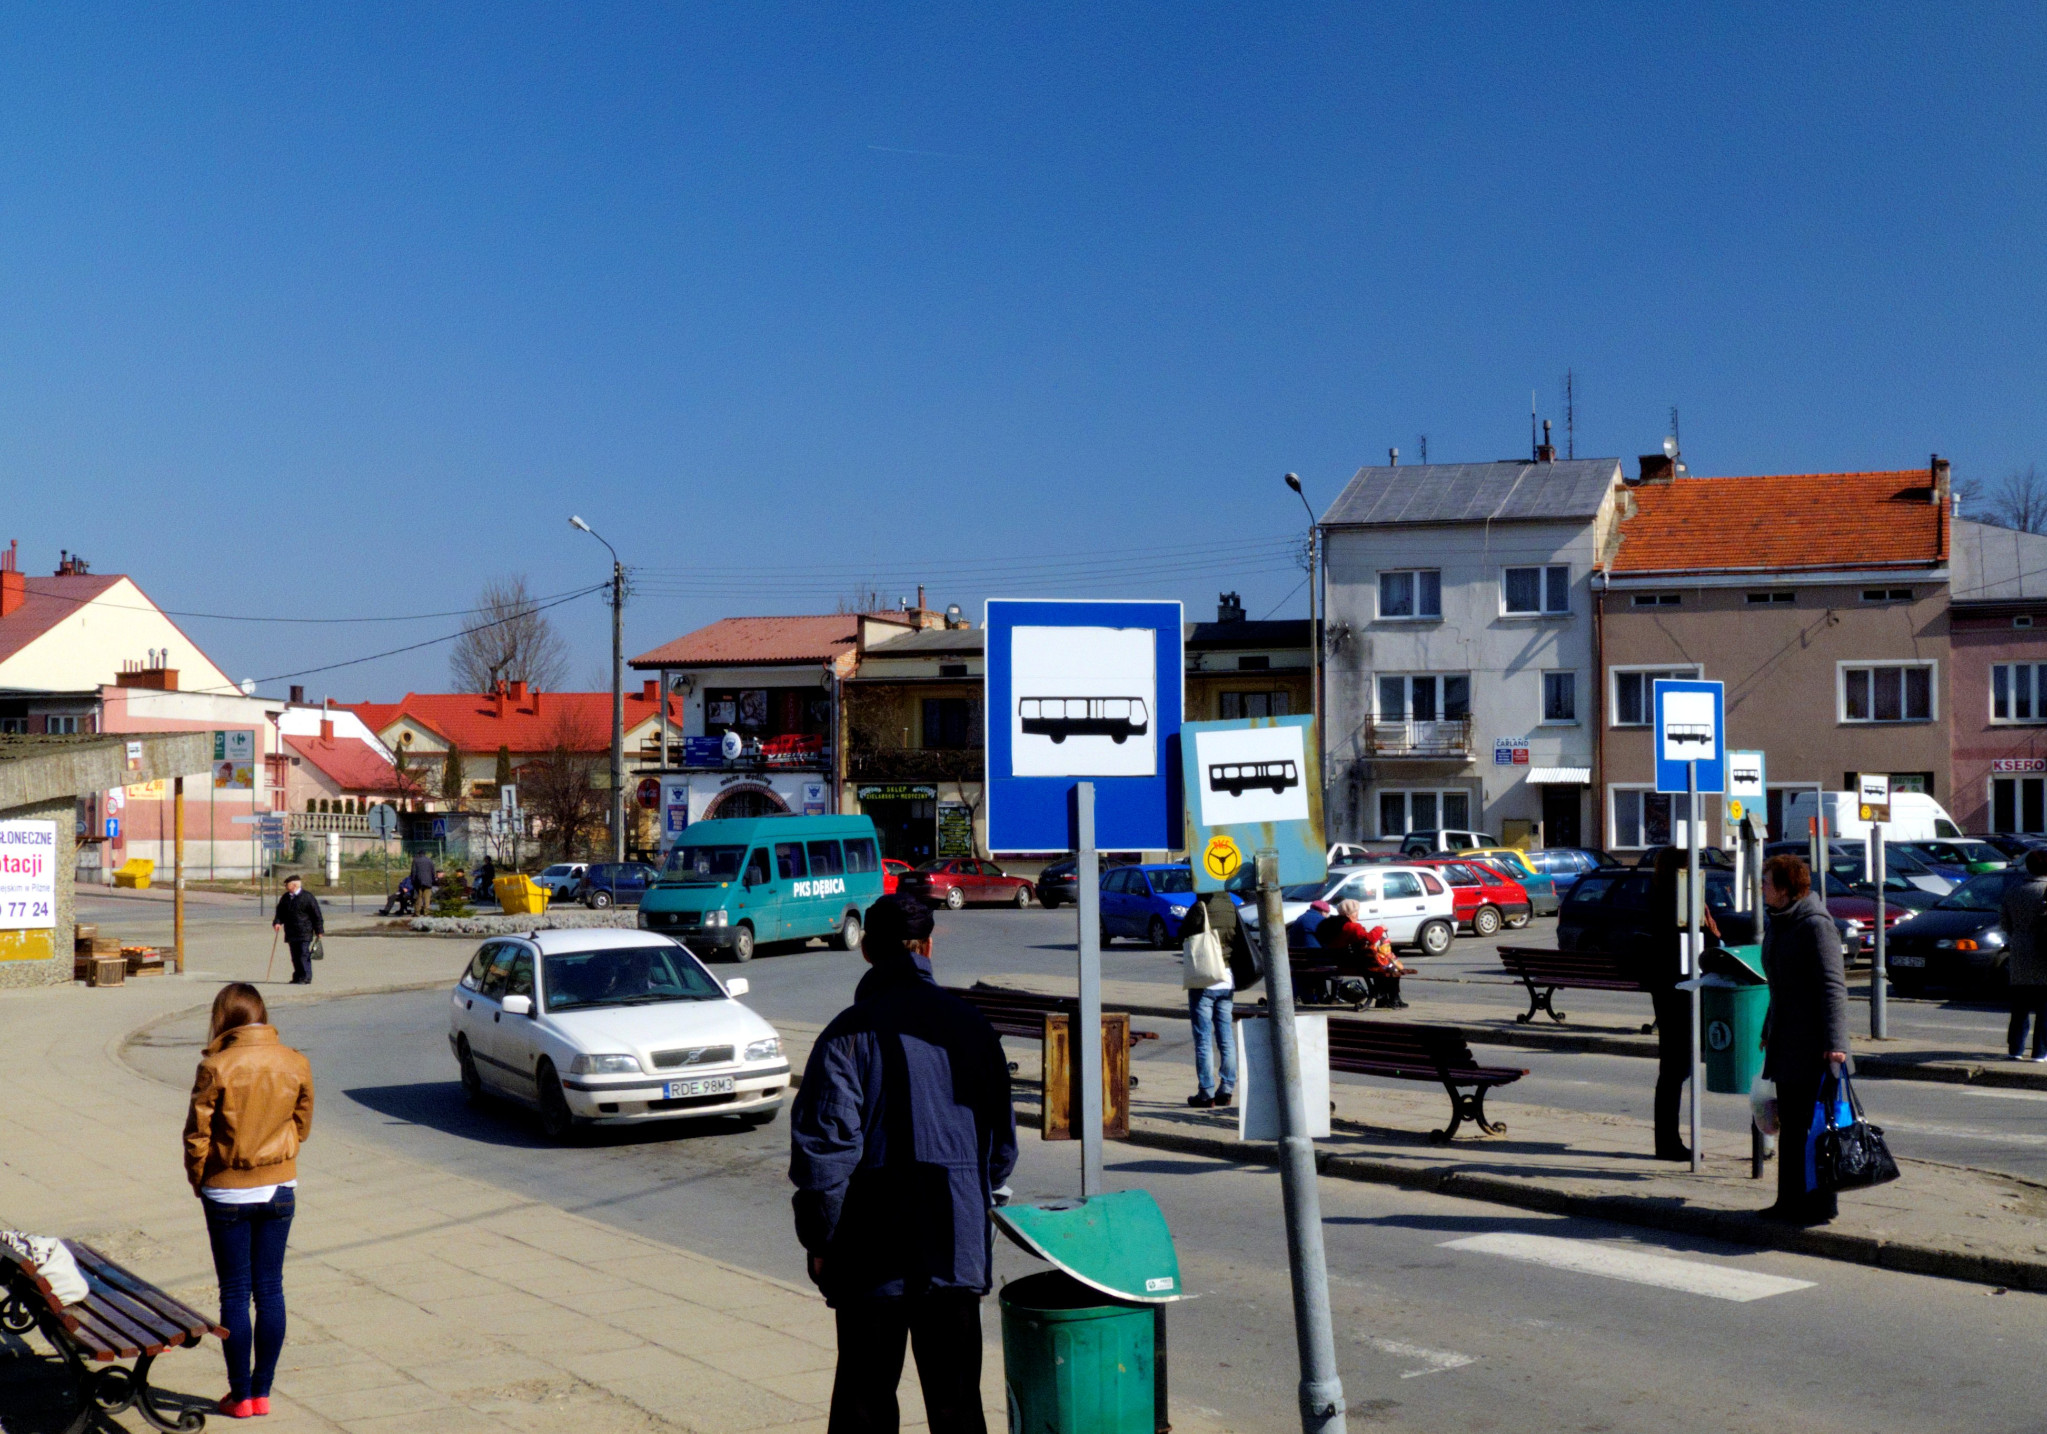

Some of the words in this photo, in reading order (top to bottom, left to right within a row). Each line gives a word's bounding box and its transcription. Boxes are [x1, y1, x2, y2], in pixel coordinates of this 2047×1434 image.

[1993, 760, 2045, 770] KSERO
[886, 785, 907, 793] SKLEP
[793, 881, 811, 898] PKS
[812, 878, 845, 898] DĘBICA
[32, 902, 49, 917] 24
[671, 1082, 699, 1097] RDE
[703, 1078, 733, 1093] 98M3
